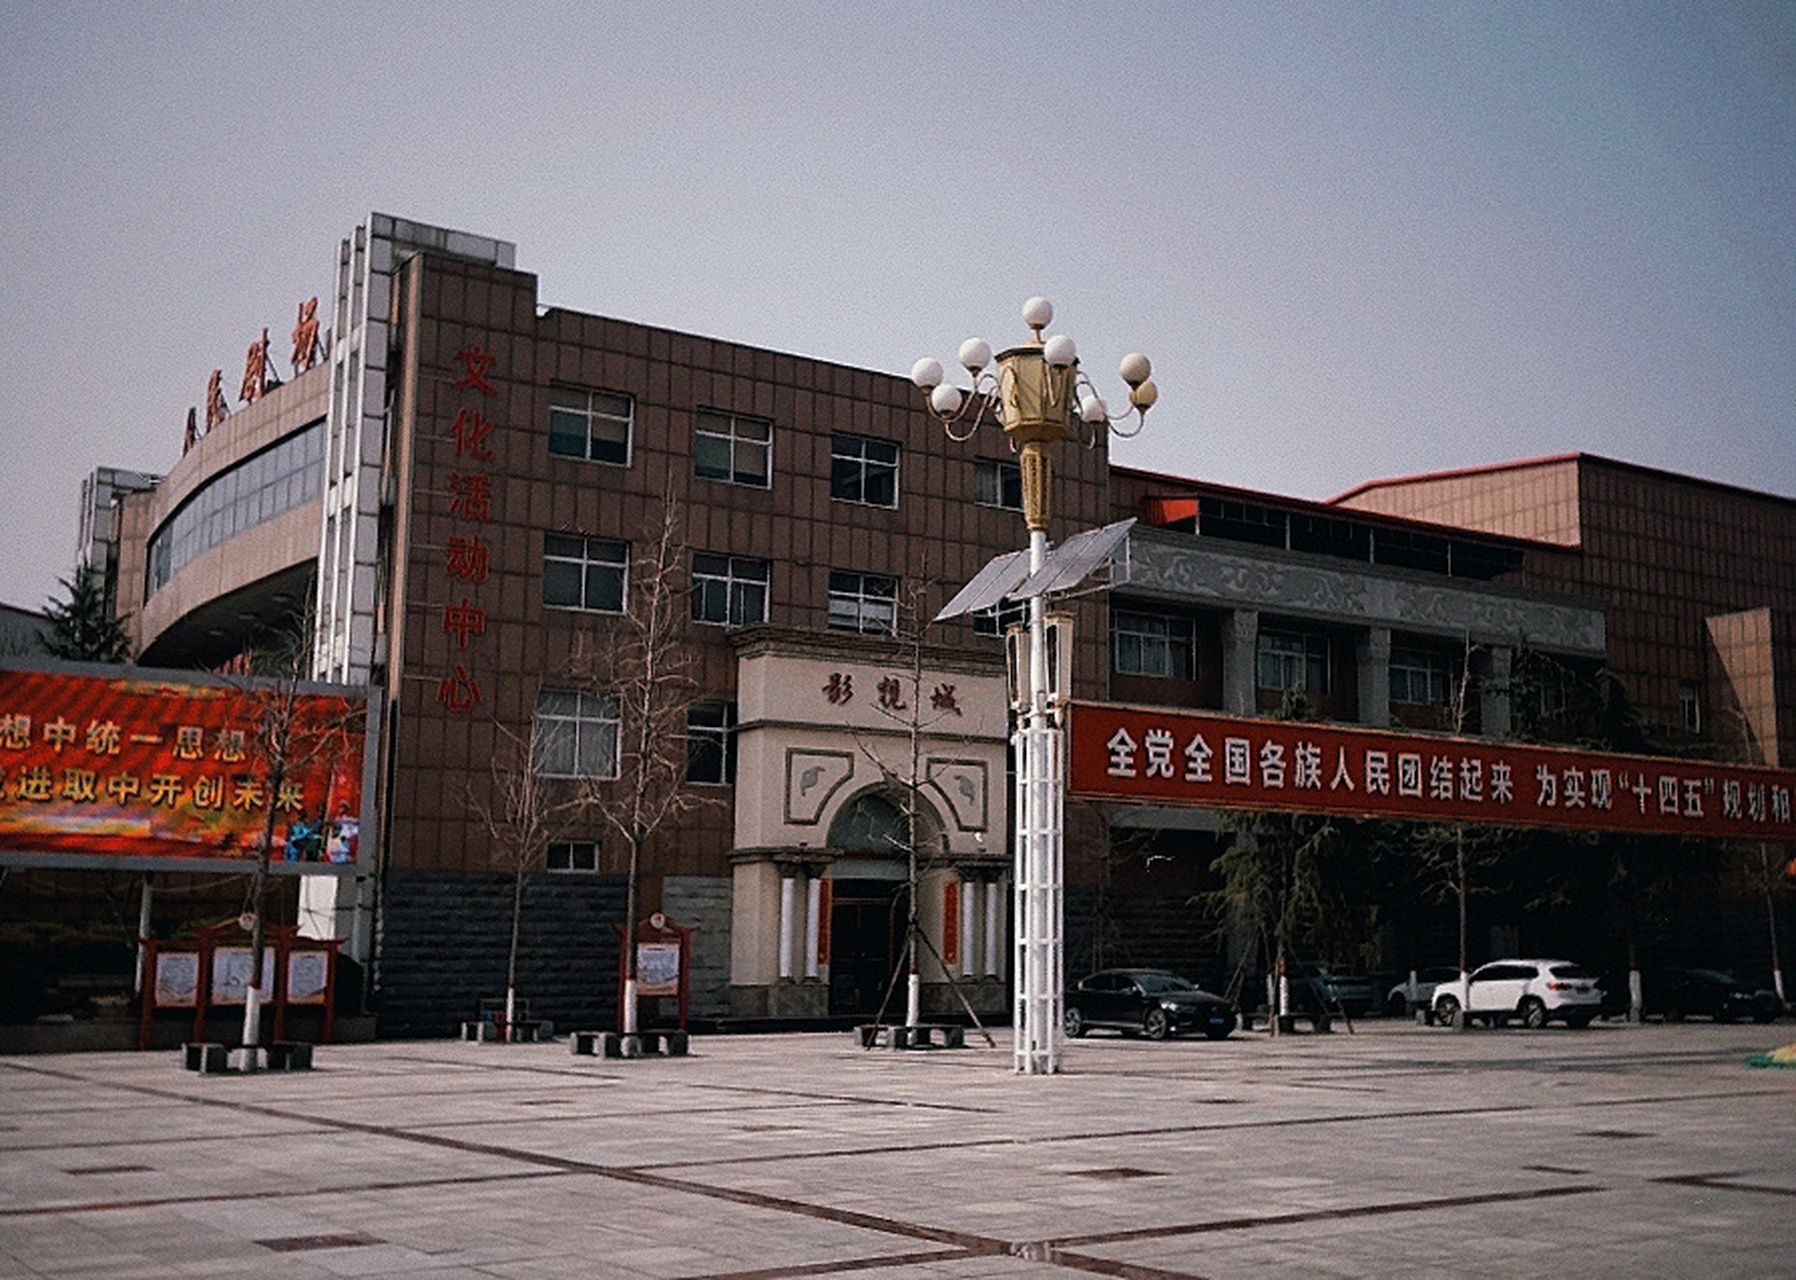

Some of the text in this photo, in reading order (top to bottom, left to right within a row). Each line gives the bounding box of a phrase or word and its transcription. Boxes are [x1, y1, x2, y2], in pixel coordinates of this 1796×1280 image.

[436, 346, 497, 714] 文化活动中心
[0, 713, 246, 762] 想中统一思想
[1106, 727, 1513, 803] 全党全国各族人民团结起来
[0, 765, 304, 813] 进取中开创未来
